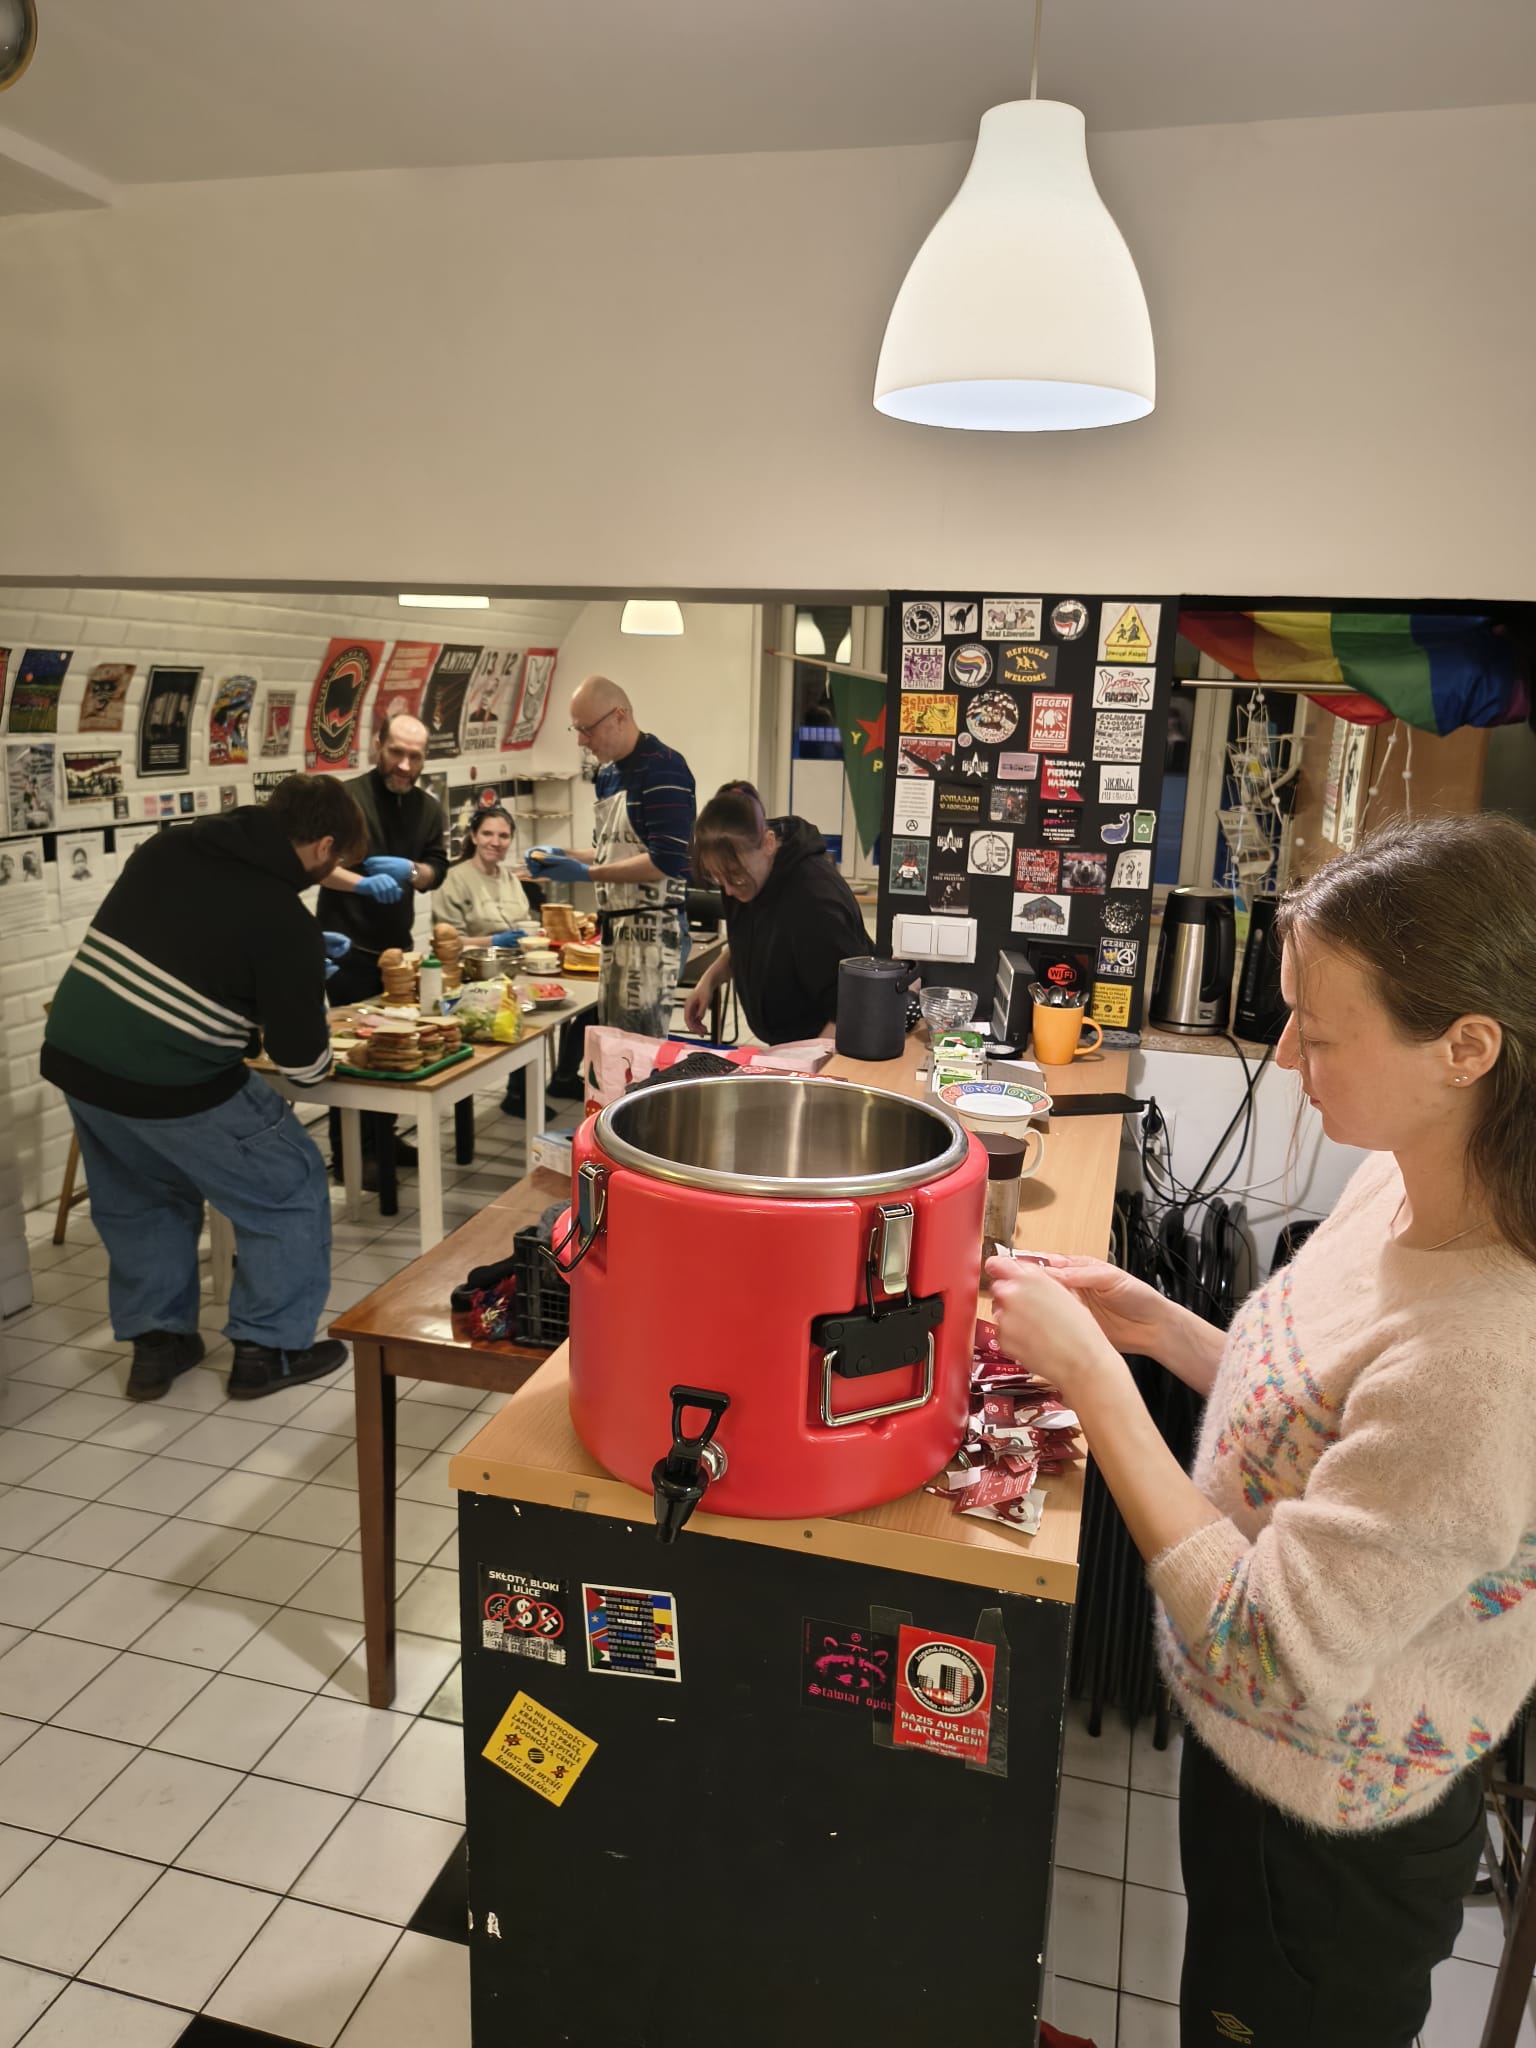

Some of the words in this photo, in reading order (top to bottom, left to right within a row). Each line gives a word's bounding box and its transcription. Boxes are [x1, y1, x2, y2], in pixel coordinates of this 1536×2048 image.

[1006, 646, 1049, 660] REFUGEES
[1004, 670, 1047, 682] WELCOME
[1036, 699, 1069, 708] GEGEN
[851, 732, 862, 744] Y
[1034, 730, 1065, 738] NAZIS
[873, 760, 884, 773] P
[514, 1585, 540, 1597] ULICE
[530, 1580, 559, 1592] BLOKI
[915, 1646, 938, 1662] Jugend
[939, 1646, 961, 1658] Antifa
[961, 1656, 978, 1674] Platte
[523, 1702, 534, 1712] TO
[535, 1710, 547, 1721] NIE
[547, 1718, 587, 1748] UCHODŹCY
[901, 1711, 934, 1726] NAZIS
[937, 1720, 959, 1732] AUS
[962, 1726, 985, 1737] DER
[550, 1728, 558, 1738] CI
[902, 1722, 941, 1737] PLATTE
[944, 1731, 982, 1747] JAGEN!
[500, 1745, 523, 1764] Masz
[523, 1762, 536, 1773] na
[550, 1740, 582, 1764] SZPITALE
[556, 1752, 578, 1768] CENY
[496, 1754, 556, 1797] kapitalistów!
